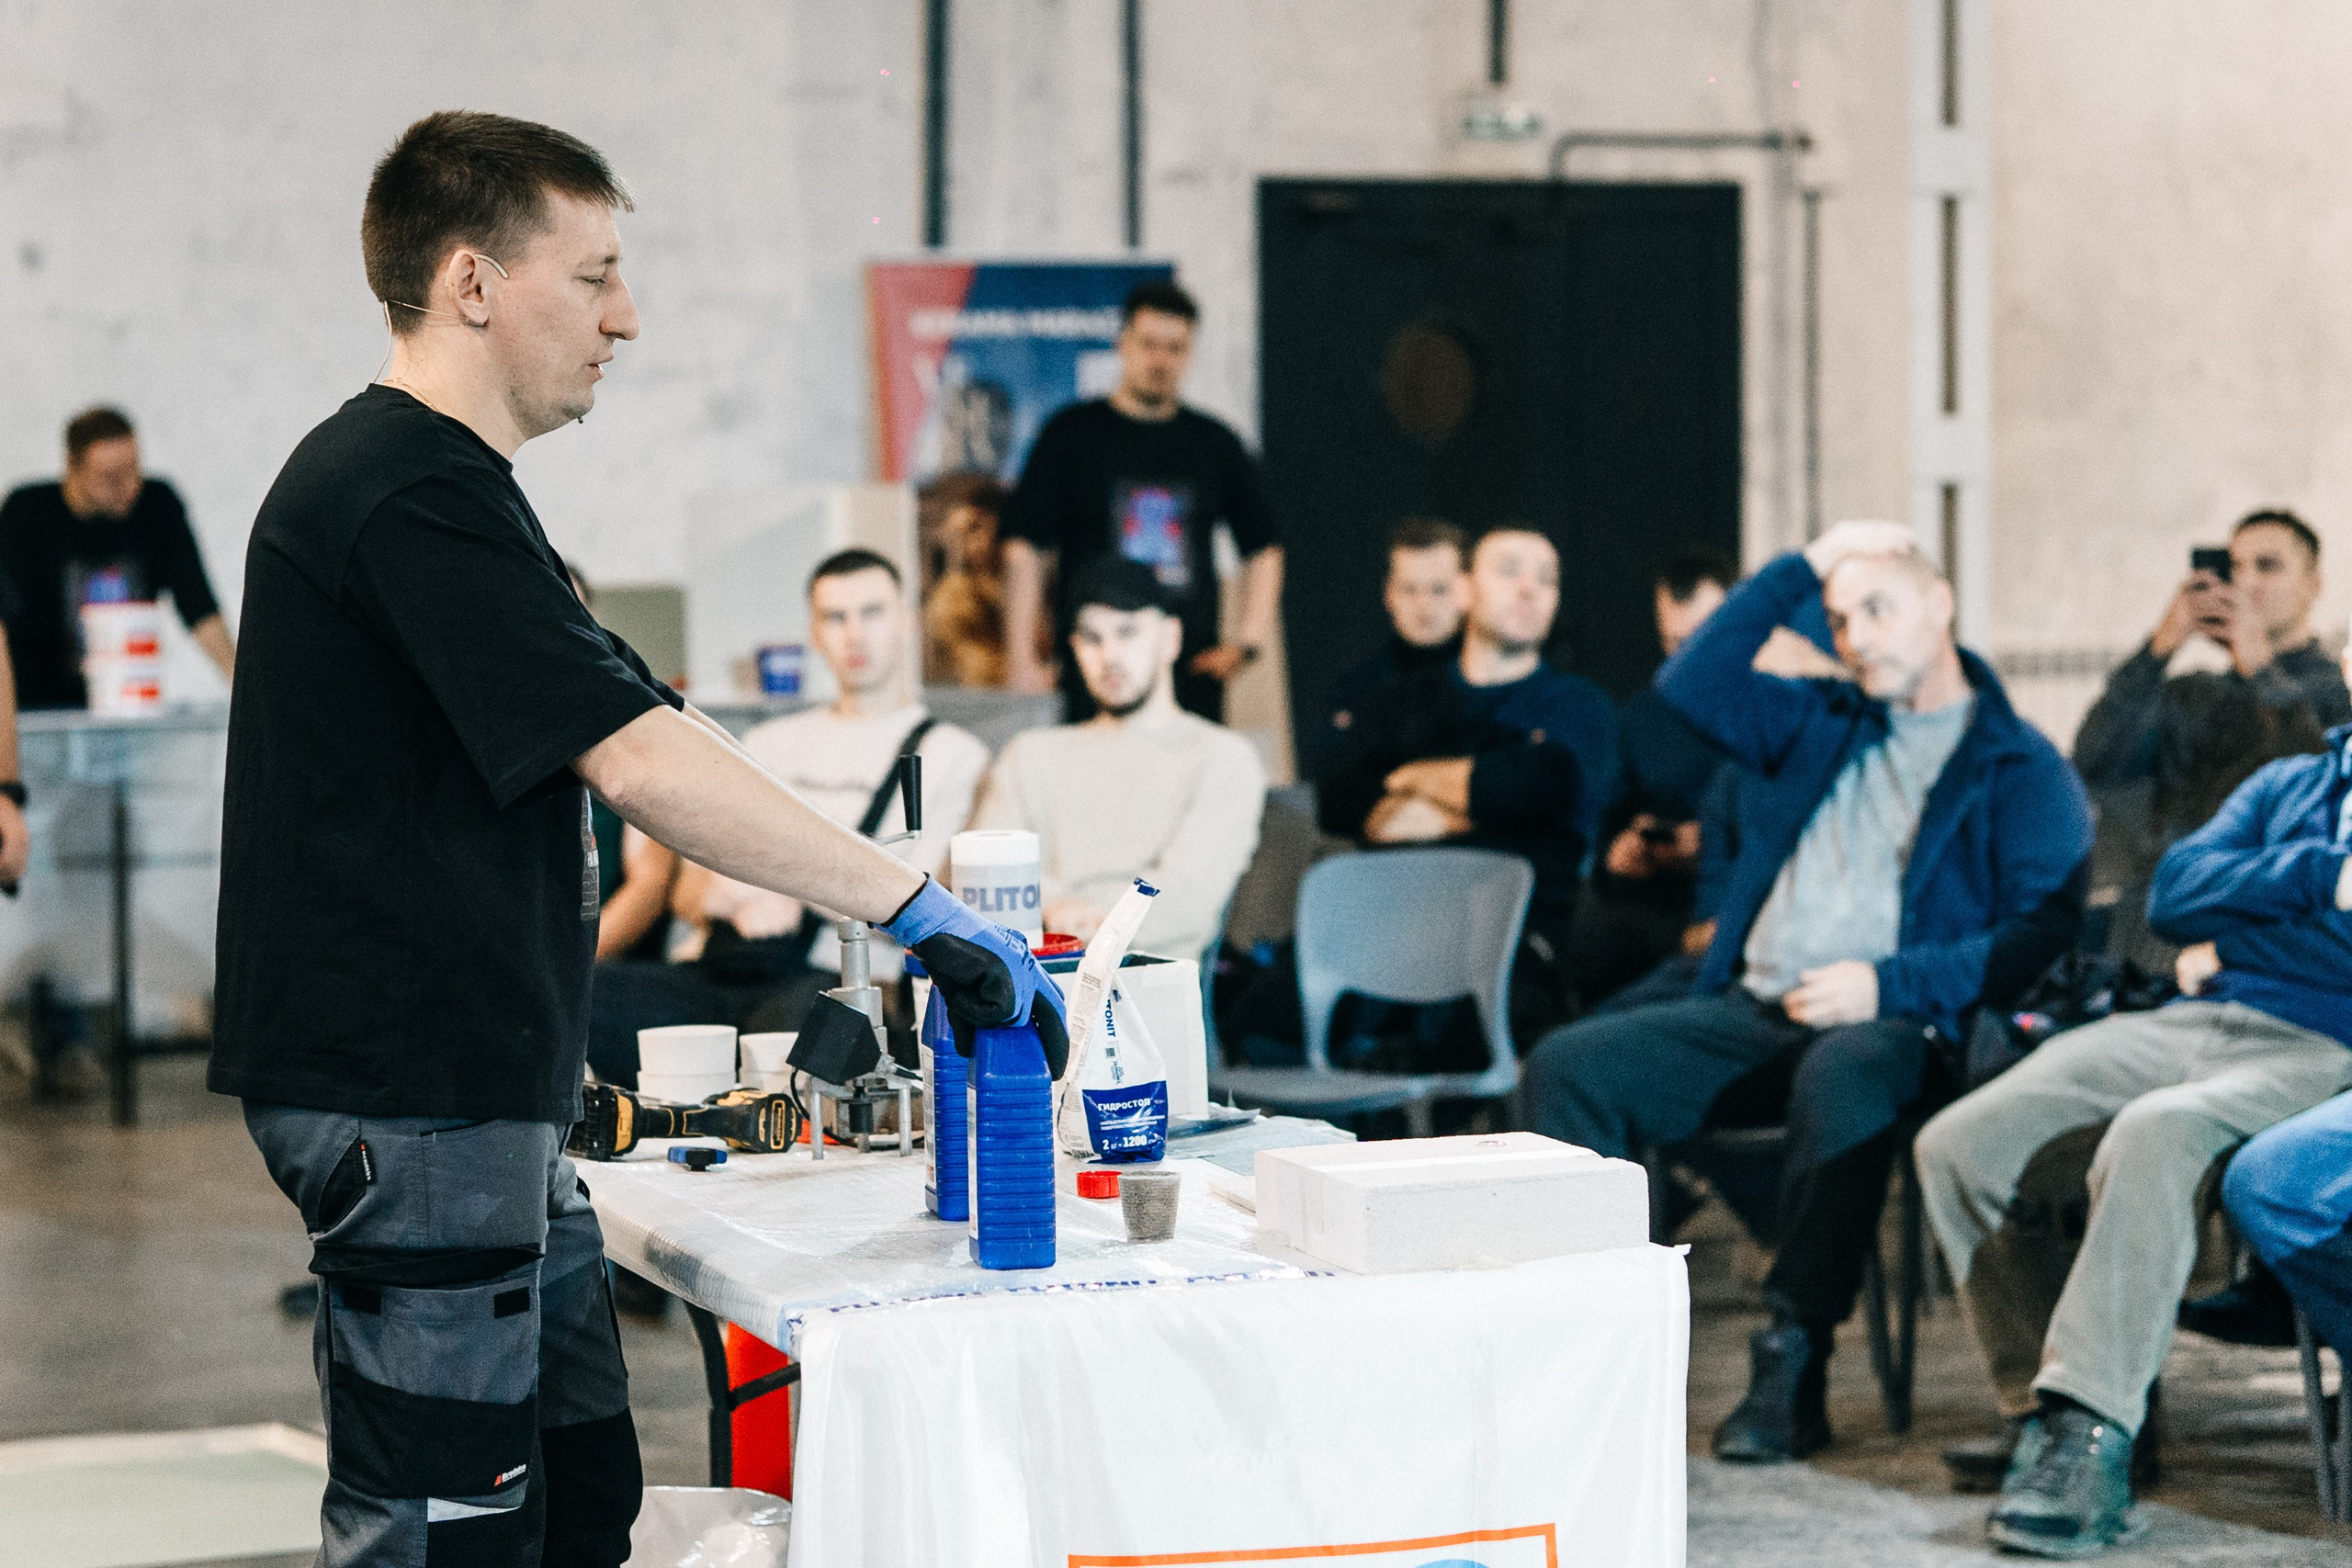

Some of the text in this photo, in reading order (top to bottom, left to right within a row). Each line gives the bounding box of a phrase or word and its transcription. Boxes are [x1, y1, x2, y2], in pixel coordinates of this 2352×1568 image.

[962, 885, 1041, 911] PLITO
[1104, 999, 1116, 1037] TONIT
[1097, 1098, 1151, 1111] ГИДРОСТОП
[1102, 1139, 1110, 1151] 2
[1122, 1134, 1148, 1147] 1200
